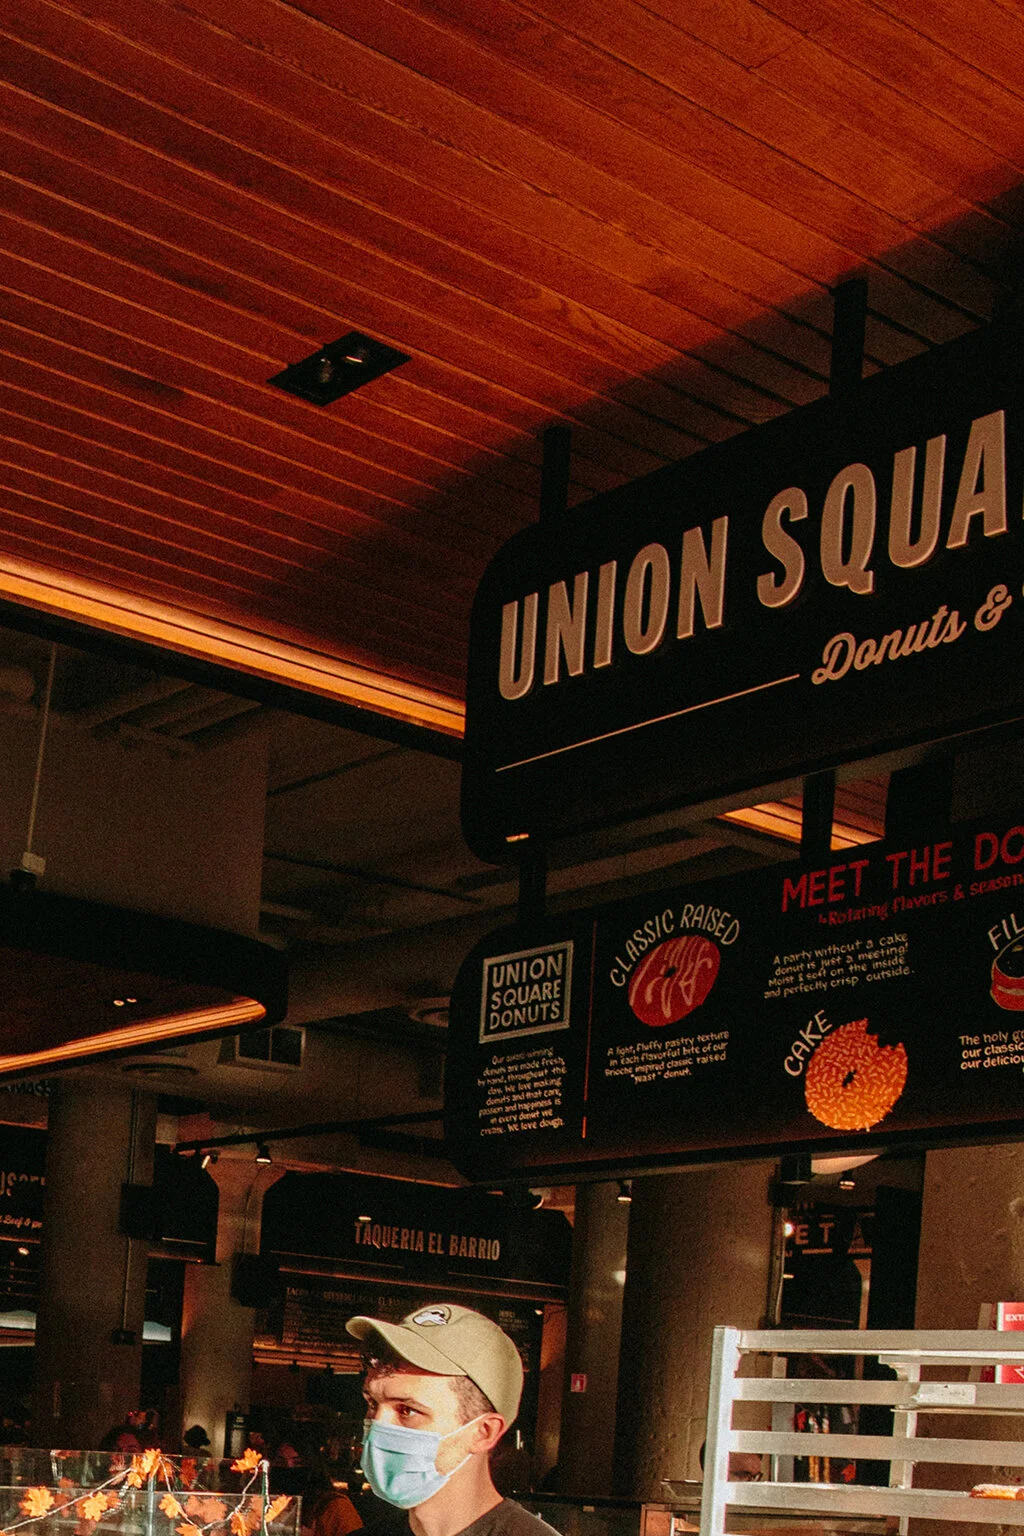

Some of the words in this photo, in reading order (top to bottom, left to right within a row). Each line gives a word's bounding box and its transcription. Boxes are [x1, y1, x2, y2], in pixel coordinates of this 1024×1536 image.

[499, 515, 728, 700] UNION
[811, 605, 966, 685] Donuts
[975, 584, 1013, 632] &
[781, 859, 870, 912] MEET
[885, 841, 953, 890] THE
[974, 825, 1024, 871] DO
[610, 908, 675, 987] CLASSIC
[680, 903, 740, 945] RAISED
[773, 955, 781, 965] A
[783, 950, 812, 965] party
[814, 939, 863, 958] without
[865, 939, 874, 949] a
[879, 932, 909, 947] cake
[775, 962, 805, 976] donut
[806, 960, 816, 970] is
[821, 955, 842, 969] just
[845, 954, 854, 964] a
[858, 942, 909, 960] meeting!
[492, 953, 563, 988] UNION
[763, 987, 781, 999] and
[783, 980, 828, 998] perfectly
[830, 975, 860, 988] crisp
[866, 965, 916, 982] outside.
[768, 975, 795, 988] Moist
[806, 967, 826, 981] soft
[830, 967, 845, 977] on
[848, 961, 868, 974] the
[872, 955, 905, 970] inside
[491, 979, 562, 1010] SQUARE
[489, 1001, 561, 1030] DONUTS
[621, 1054, 640, 1065] each
[640, 1048, 681, 1061] flavorful
[683, 1045, 701, 1056] bite
[702, 1043, 712, 1053] of
[713, 1041, 728, 1051] our
[636, 1040, 663, 1052] fluffy
[665, 1036, 695, 1050] pastry
[697, 1030, 730, 1043] texture
[784, 1009, 833, 1076] CAKE
[958, 1034, 981, 1046] The
[982, 1031, 1009, 1043] holy
[961, 1048, 982, 1059] our
[984, 1042, 1024, 1056] classic
[666, 1057, 694, 1069] classic
[696, 1051, 727, 1064] raised
[960, 1059, 982, 1070] our
[354, 1220, 425, 1253] TAQUERIA
[428, 1231, 445, 1255] EL
[449, 1234, 501, 1262] BARRIO
